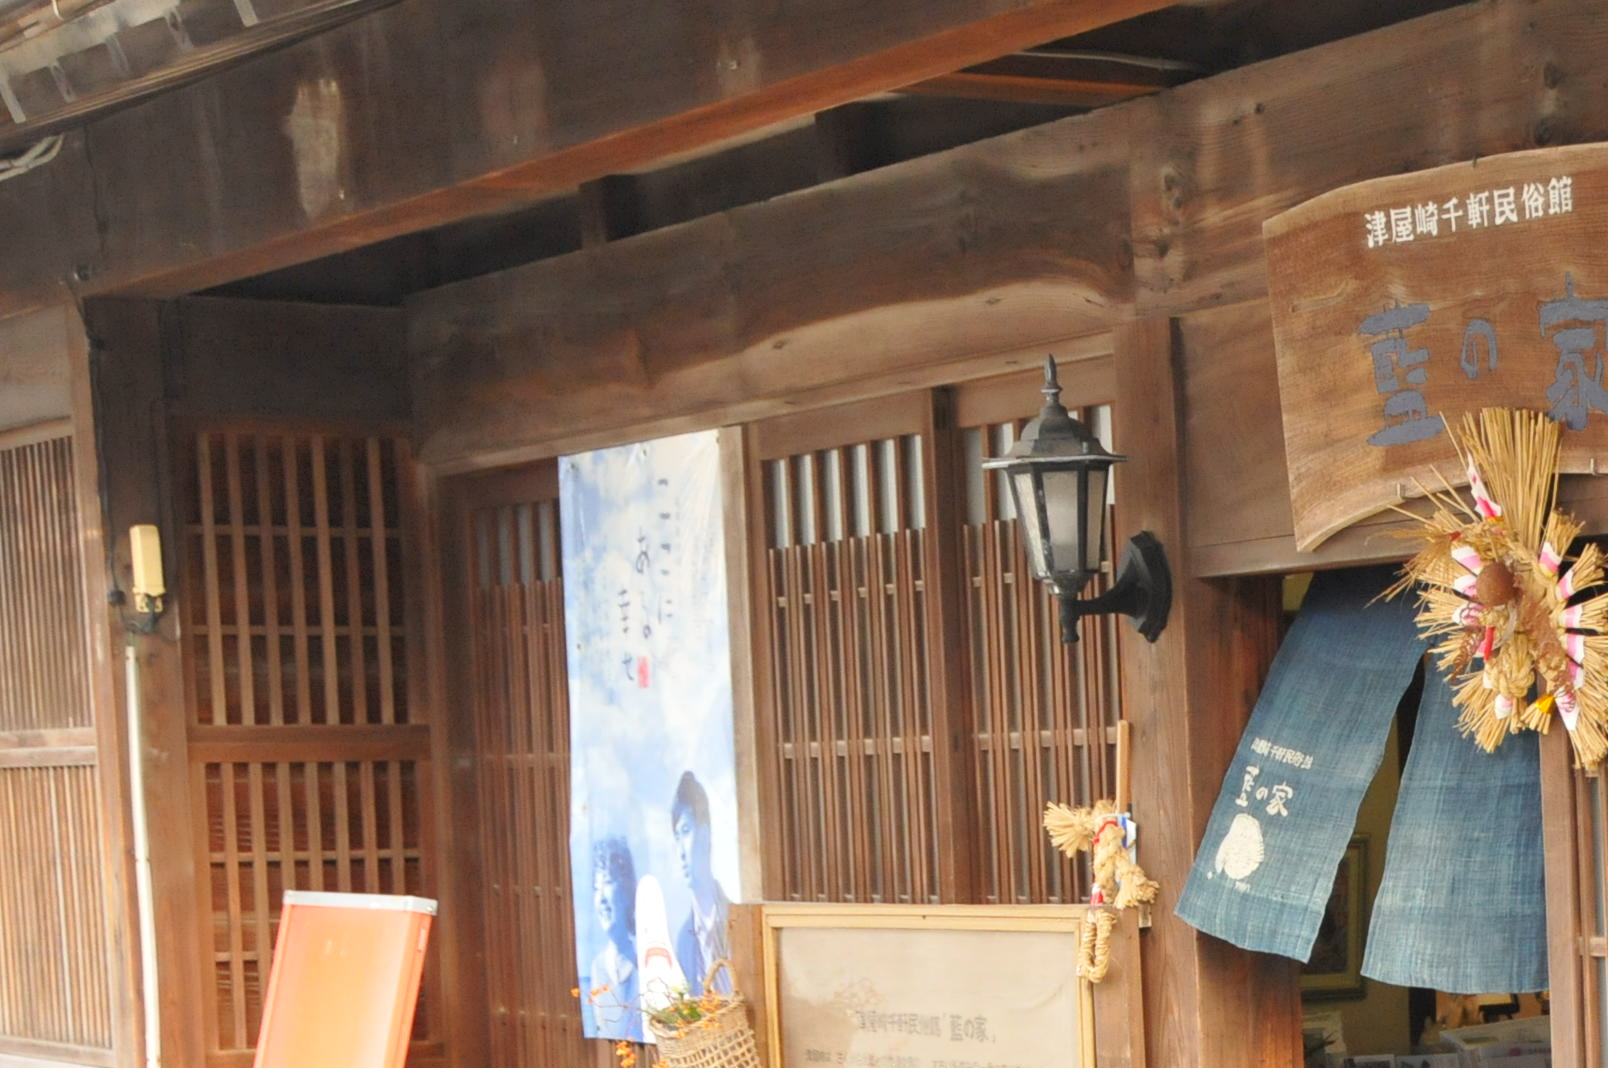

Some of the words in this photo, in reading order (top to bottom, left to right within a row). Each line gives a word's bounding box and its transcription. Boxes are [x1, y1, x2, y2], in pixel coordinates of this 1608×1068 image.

[1364, 177, 1574, 248] 津屋崎千軒民俗館
